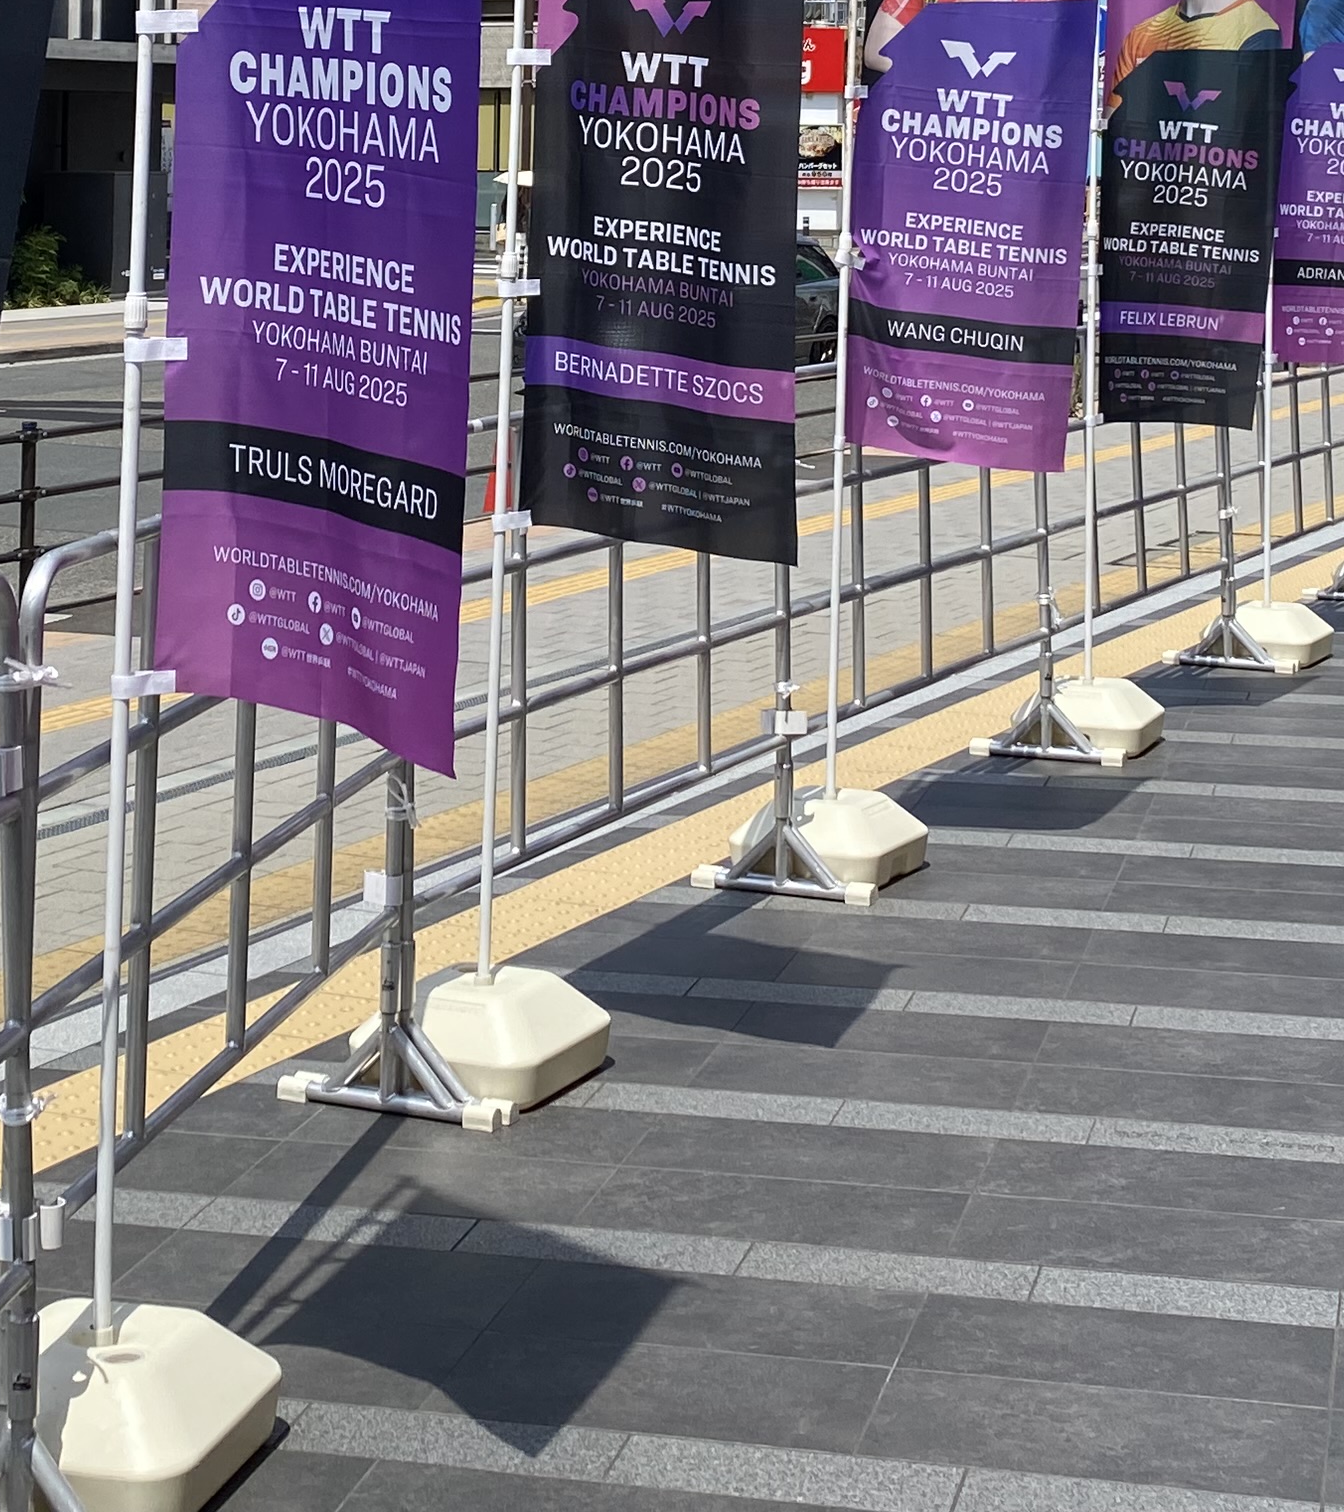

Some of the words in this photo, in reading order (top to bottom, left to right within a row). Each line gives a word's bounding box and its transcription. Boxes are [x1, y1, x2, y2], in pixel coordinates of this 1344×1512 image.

[298, 6, 392, 55] WTT
[229, 50, 453, 114] CHAMPIONS
[621, 51, 709, 88] WTT
[570, 80, 762, 131] CHAMPIONS
[937, 88, 1014, 117] WTT
[245, 100, 441, 164] YOKOHAMA
[578, 115, 746, 165] YOKOHAMA
[881, 108, 1063, 149] CHAMPIONS
[1159, 120, 1219, 144] WTT
[891, 136, 1050, 175] YOKOHAMA
[1113, 137, 1259, 170] CHAMPIONS
[305, 156, 387, 209] 2025
[620, 155, 702, 193] 2025
[933, 167, 1003, 197] 2025
[1120, 159, 1247, 191] YOKOHAMA
[1153, 184, 1209, 207] 2025
[1279, 203, 1323, 217] WORLD
[593, 215, 722, 253] EXPERIENCE
[905, 212, 1024, 241] EXPERIENCE
[1130, 221, 1225, 243] EXPERIENCE
[546, 235, 618, 266] WORLD
[622, 247, 694, 276] TABLE
[697, 257, 776, 286] TENNIS
[860, 228, 928, 251] WORLD
[932, 236, 992, 259] TABLE
[996, 244, 1068, 265] TENNIS
[1103, 237, 1147, 253] WORLD
[1150, 241, 1198, 257] TABLE
[1202, 245, 1260, 263] TENNIS
[273, 243, 415, 295] EXPERIENCE
[888, 252, 974, 276] YOKOHAMA
[977, 263, 1033, 282] BUNTAI
[581, 268, 676, 297] YOKOHAMA
[679, 282, 734, 308] BUNTAI
[941, 277, 972, 293] AUG
[976, 281, 1014, 298] 2025
[199, 276, 305, 315] WORLD
[309, 288, 377, 331] TABLE
[382, 302, 462, 346] TENNIS
[596, 295, 605, 311] 7
[637, 301, 674, 321] AUG
[678, 305, 717, 329] 2025
[1119, 310, 1157, 326] FELIX
[1159, 313, 1220, 331] LEBRUN
[252, 319, 356, 361] YOKOHAMA
[360, 340, 428, 376] BUNTAI
[887, 319, 945, 343] WANG
[950, 327, 1024, 352] CHUQIN
[275, 358, 287, 382] 7
[304, 363, 318, 388] 11
[322, 368, 355, 396] AUG
[358, 374, 408, 408] 2025
[554, 351, 689, 393] BERNADETTE
[692, 373, 764, 405] SZOCS
[553, 422, 763, 469] WORLDTABLETENNIS.COM/YOKOHAMA
[229, 442, 313, 487] TRULS
[319, 458, 438, 520] MOREGARD
[213, 545, 439, 623] WORLDTABLETENNIS.COM/YOKOHAMA
[249, 611, 311, 635] @WTTGLOBAL
[269, 587, 297, 603] @WTT
[362, 615, 415, 645] @WTTGLOBAL
